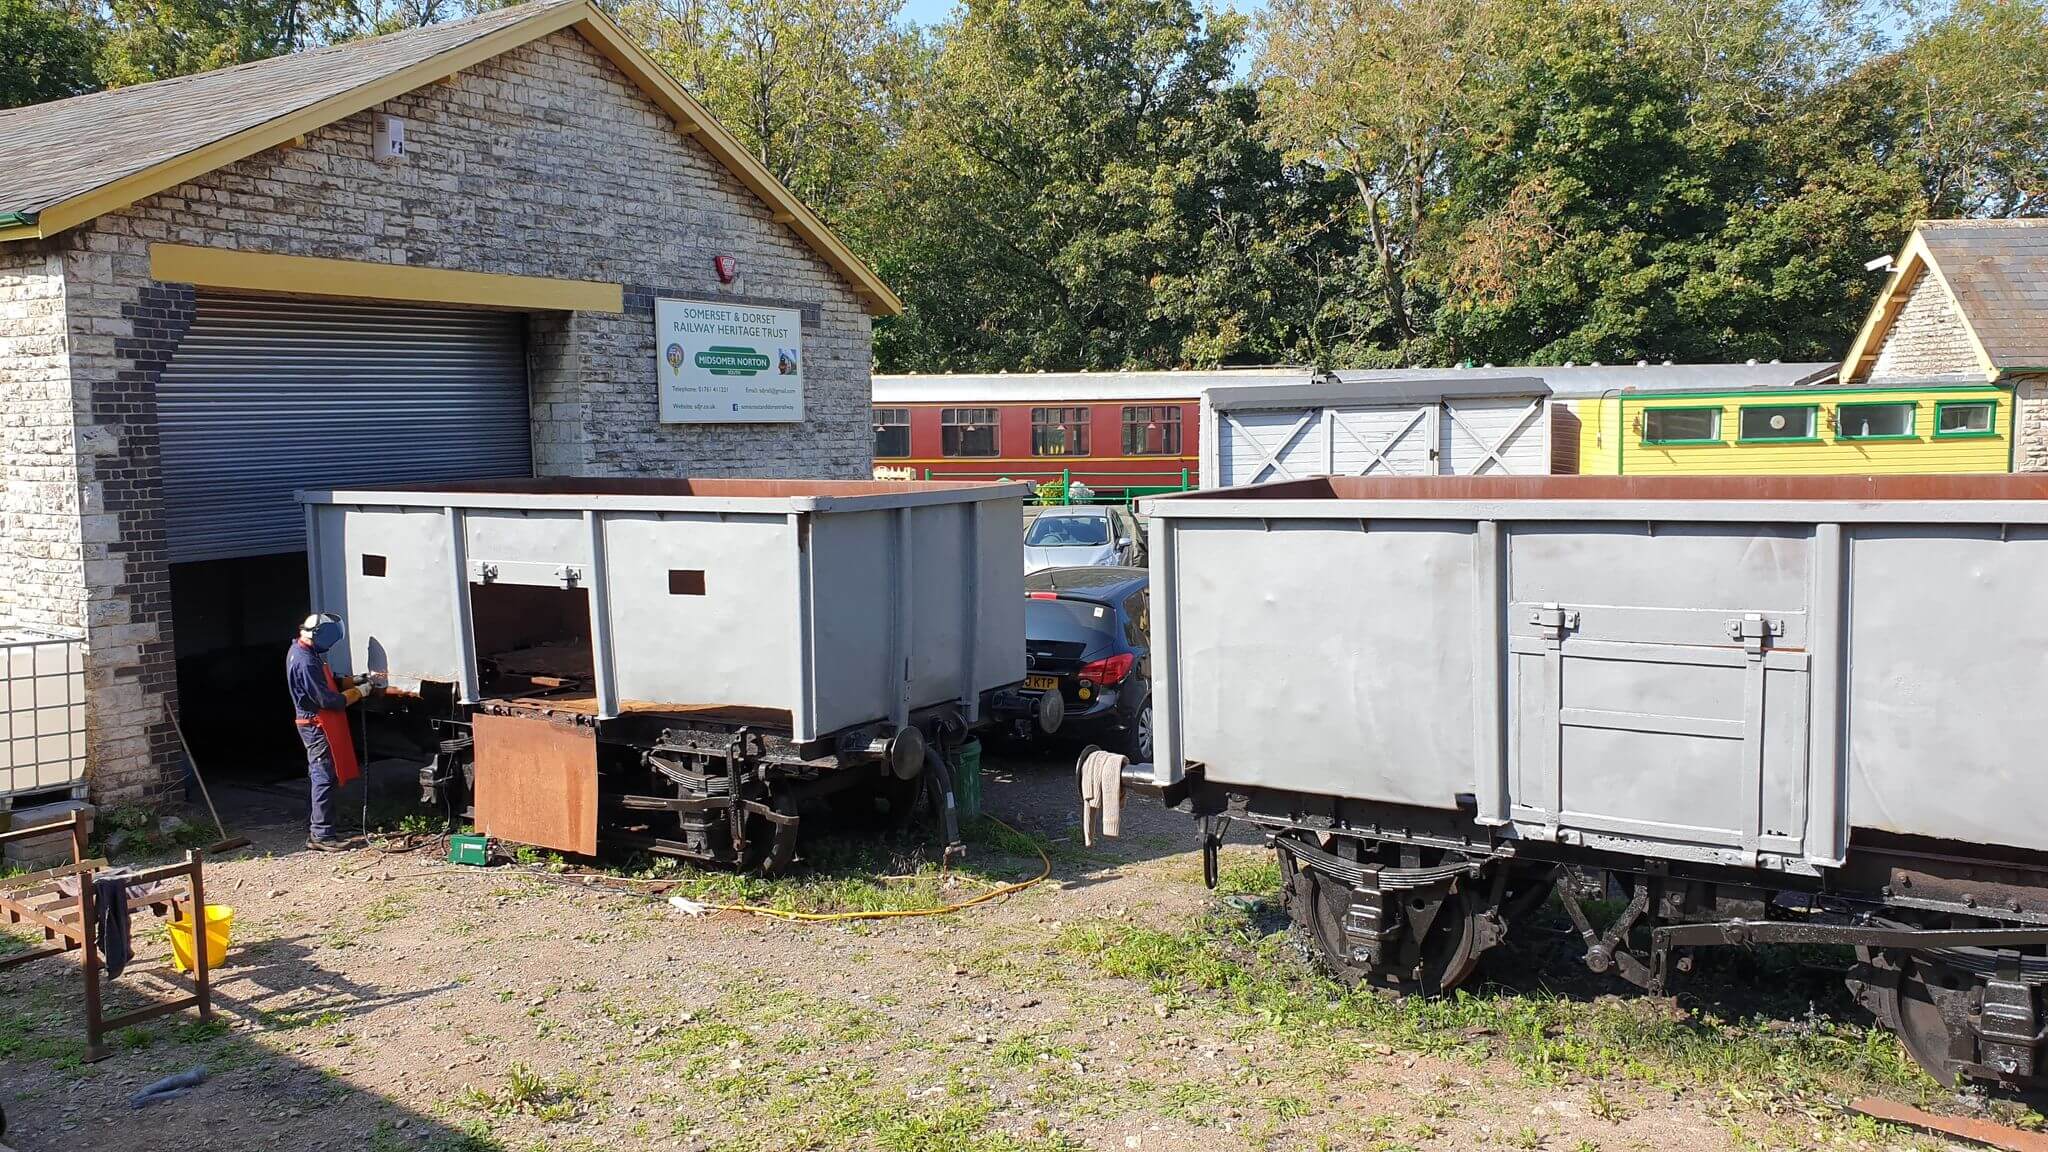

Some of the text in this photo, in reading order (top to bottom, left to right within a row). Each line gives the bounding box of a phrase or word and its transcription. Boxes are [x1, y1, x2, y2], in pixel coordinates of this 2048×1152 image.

[684, 308, 777, 325] SOMERSET & DORSET
[673, 321, 788, 339] RAILWAY HERITAGE TRUST
[698, 356, 767, 367] MIDSOMER NORTON
